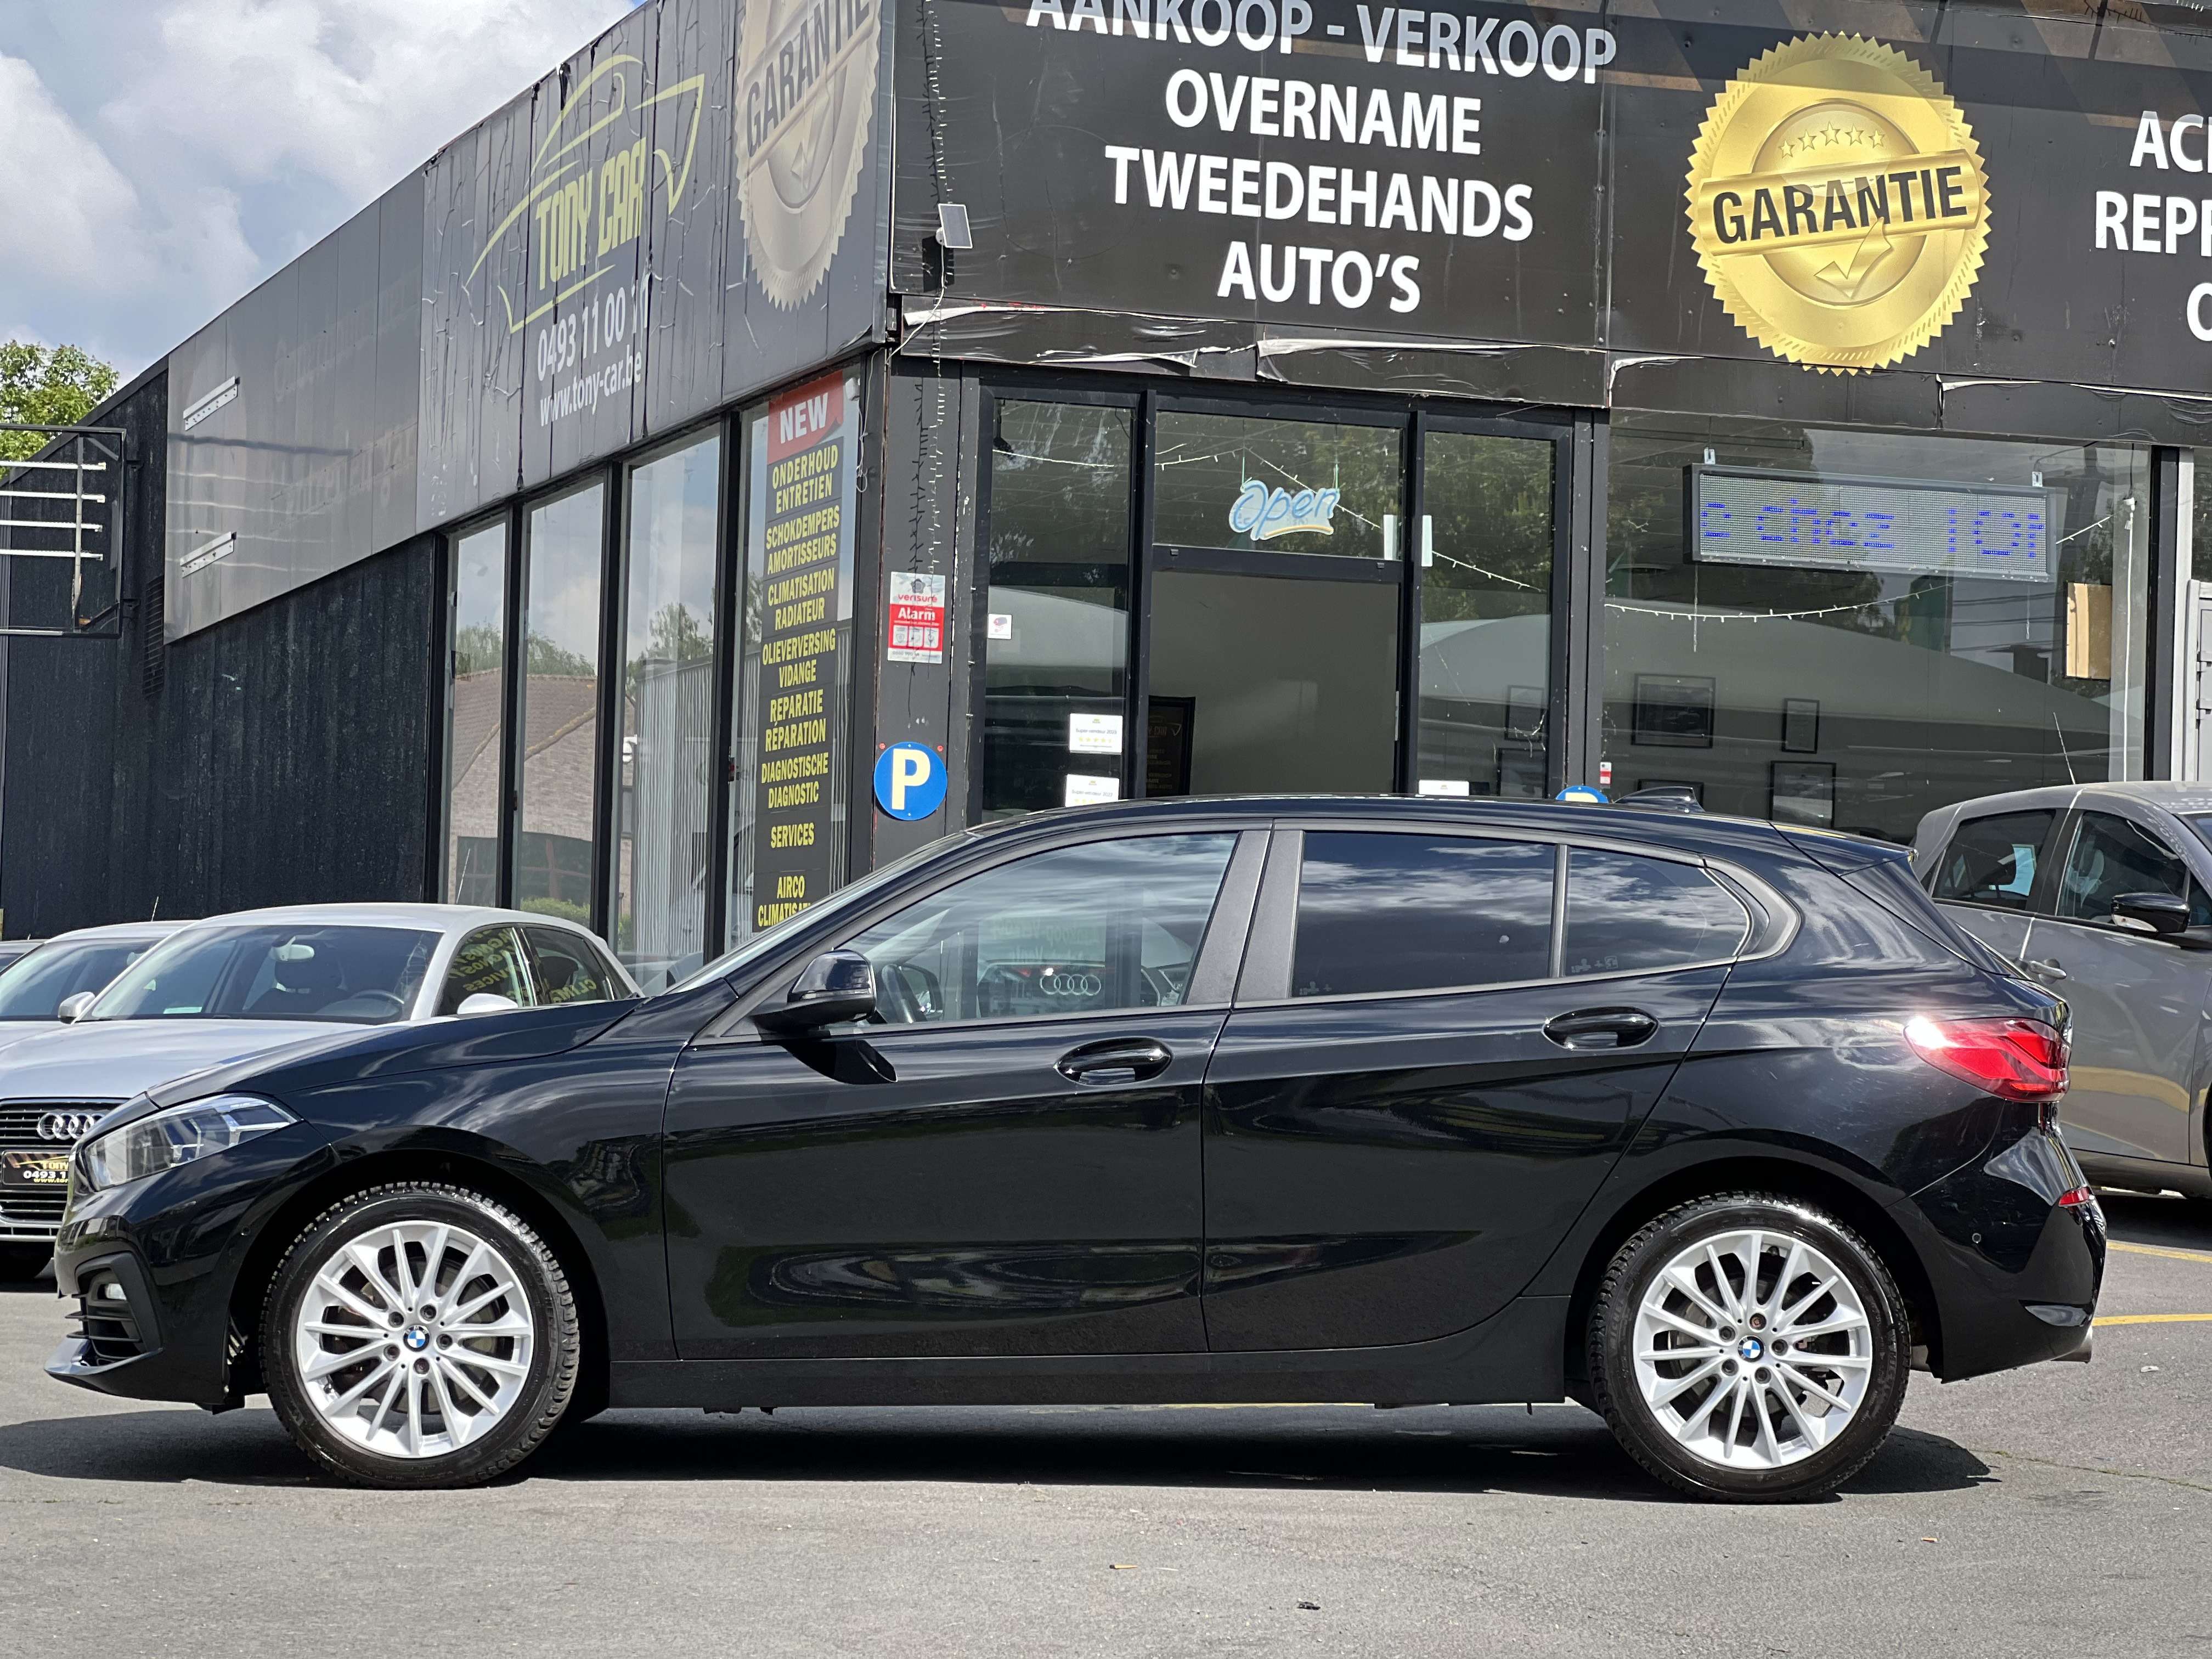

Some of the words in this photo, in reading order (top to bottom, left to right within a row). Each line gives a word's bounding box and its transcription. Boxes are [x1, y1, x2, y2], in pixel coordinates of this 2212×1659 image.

[1356, 4, 1616, 84] VERKOOP
[1165, 69, 1481, 155] OVERNAME
[2129, 110, 2212, 174] AC
[535, 167, 593, 291] TONY
[598, 137, 646, 256] CAR
[1104, 145, 1533, 242] TWEEDEHANDS
[1712, 166, 1968, 245] GARANTIE
[1217, 241, 1421, 314] AUTO'S
[538, 313, 576, 381] 0493
[582, 300, 599, 359] 11
[605, 287, 625, 348] 00
[540, 344, 641, 426] www.tony-car.be
[780, 393, 828, 444] NEW
[772, 444, 838, 489] ONDERHOUD
[776, 472, 833, 514] ENTRETIEN
[1232, 481, 1338, 539] Open
[766, 505, 839, 550] SCHOKDEMPERS
[768, 534, 837, 575] AMORTISSEURS
[768, 567, 835, 607] CLIMATISATION
[897, 593, 938, 603] verisure
[775, 597, 825, 631] RADIATEUR
[898, 607, 935, 621] Alarm
[762, 628, 836, 665] OLIEVERVERSING
[779, 659, 817, 689] VIDANGE
[770, 689, 823, 723] REPARATIE
[765, 718, 826, 752] RÉPARATION
[761, 752, 828, 783] DIAGNOSTISCHE
[891, 748, 931, 810] P
[768, 781, 820, 809] DIAGNOSTIC
[770, 822, 815, 848] SERVICES
[777, 876, 805, 899] AIRCO
[758, 902, 811, 927] CLIMATIS
[23, 1170, 56, 1179] 0493
